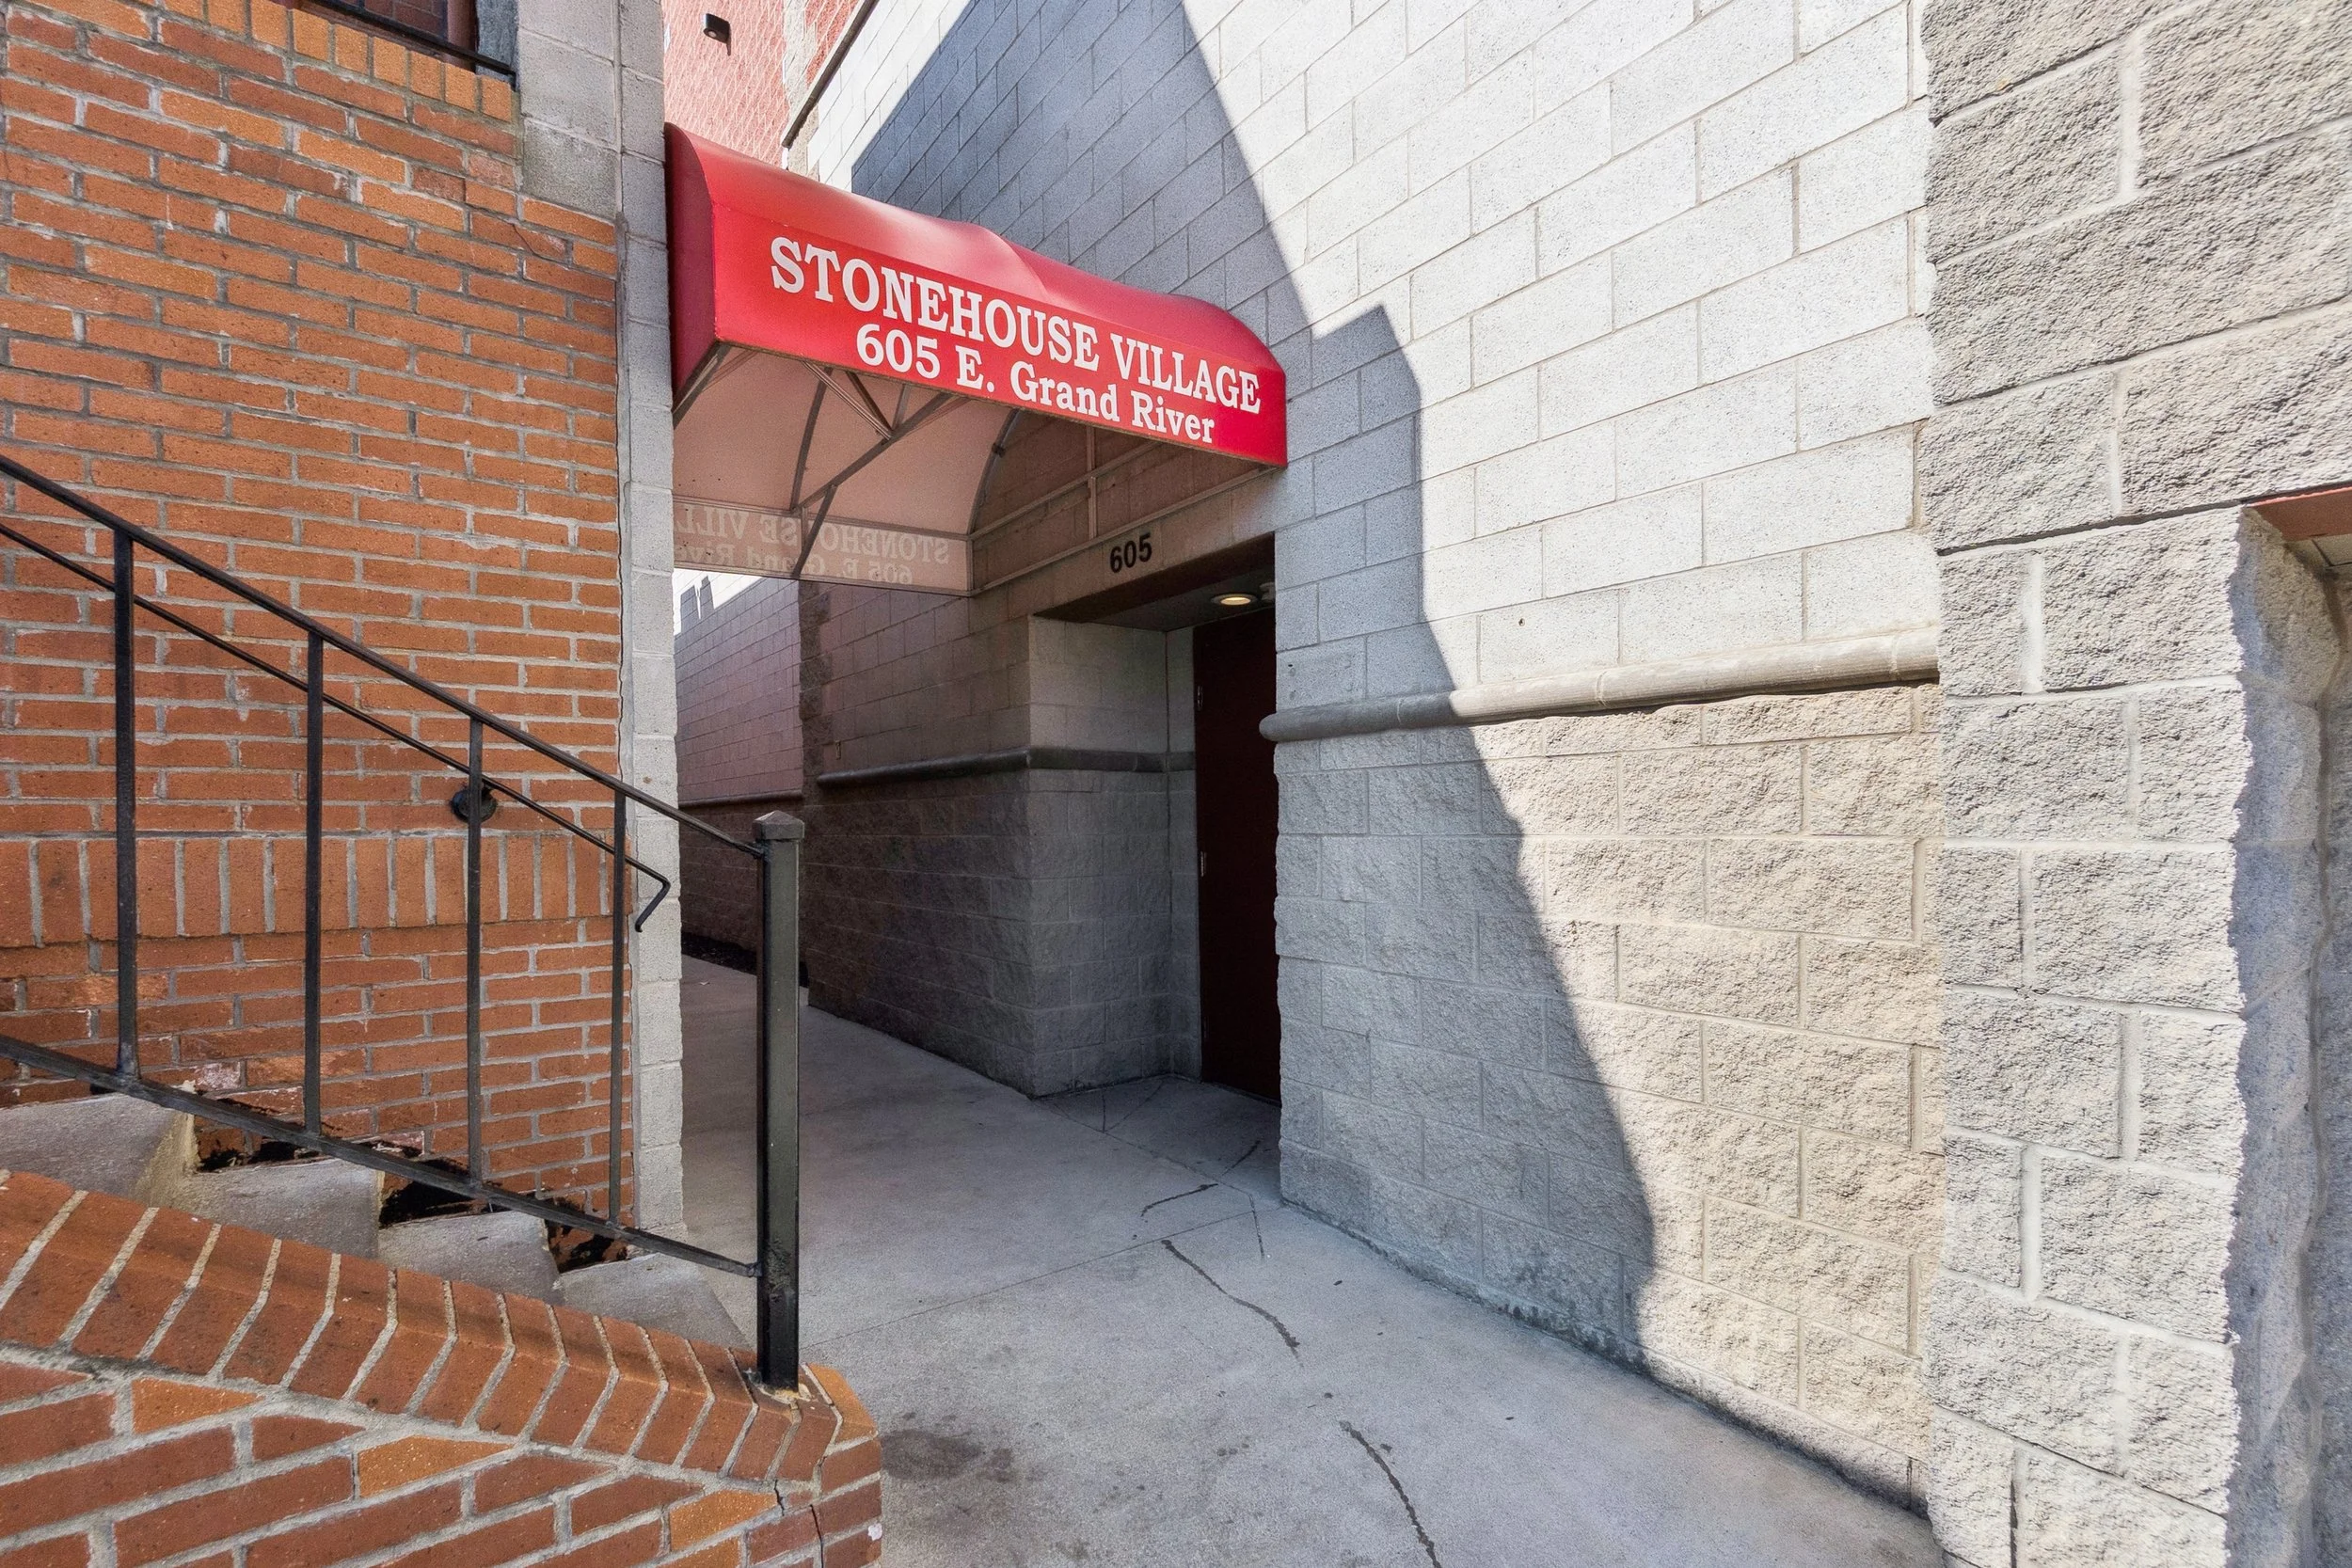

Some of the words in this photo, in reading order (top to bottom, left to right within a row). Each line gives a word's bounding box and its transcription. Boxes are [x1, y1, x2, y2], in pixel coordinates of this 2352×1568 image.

[771, 236, 1100, 372] STONEHOUSE
[1110, 333, 1262, 414] VILLAGE
[856, 324, 941, 379] 605
[955, 345, 994, 392] E.
[1010, 360, 1120, 422] Grand
[1131, 390, 1216, 444] River
[1109, 532, 1152, 574] 605
